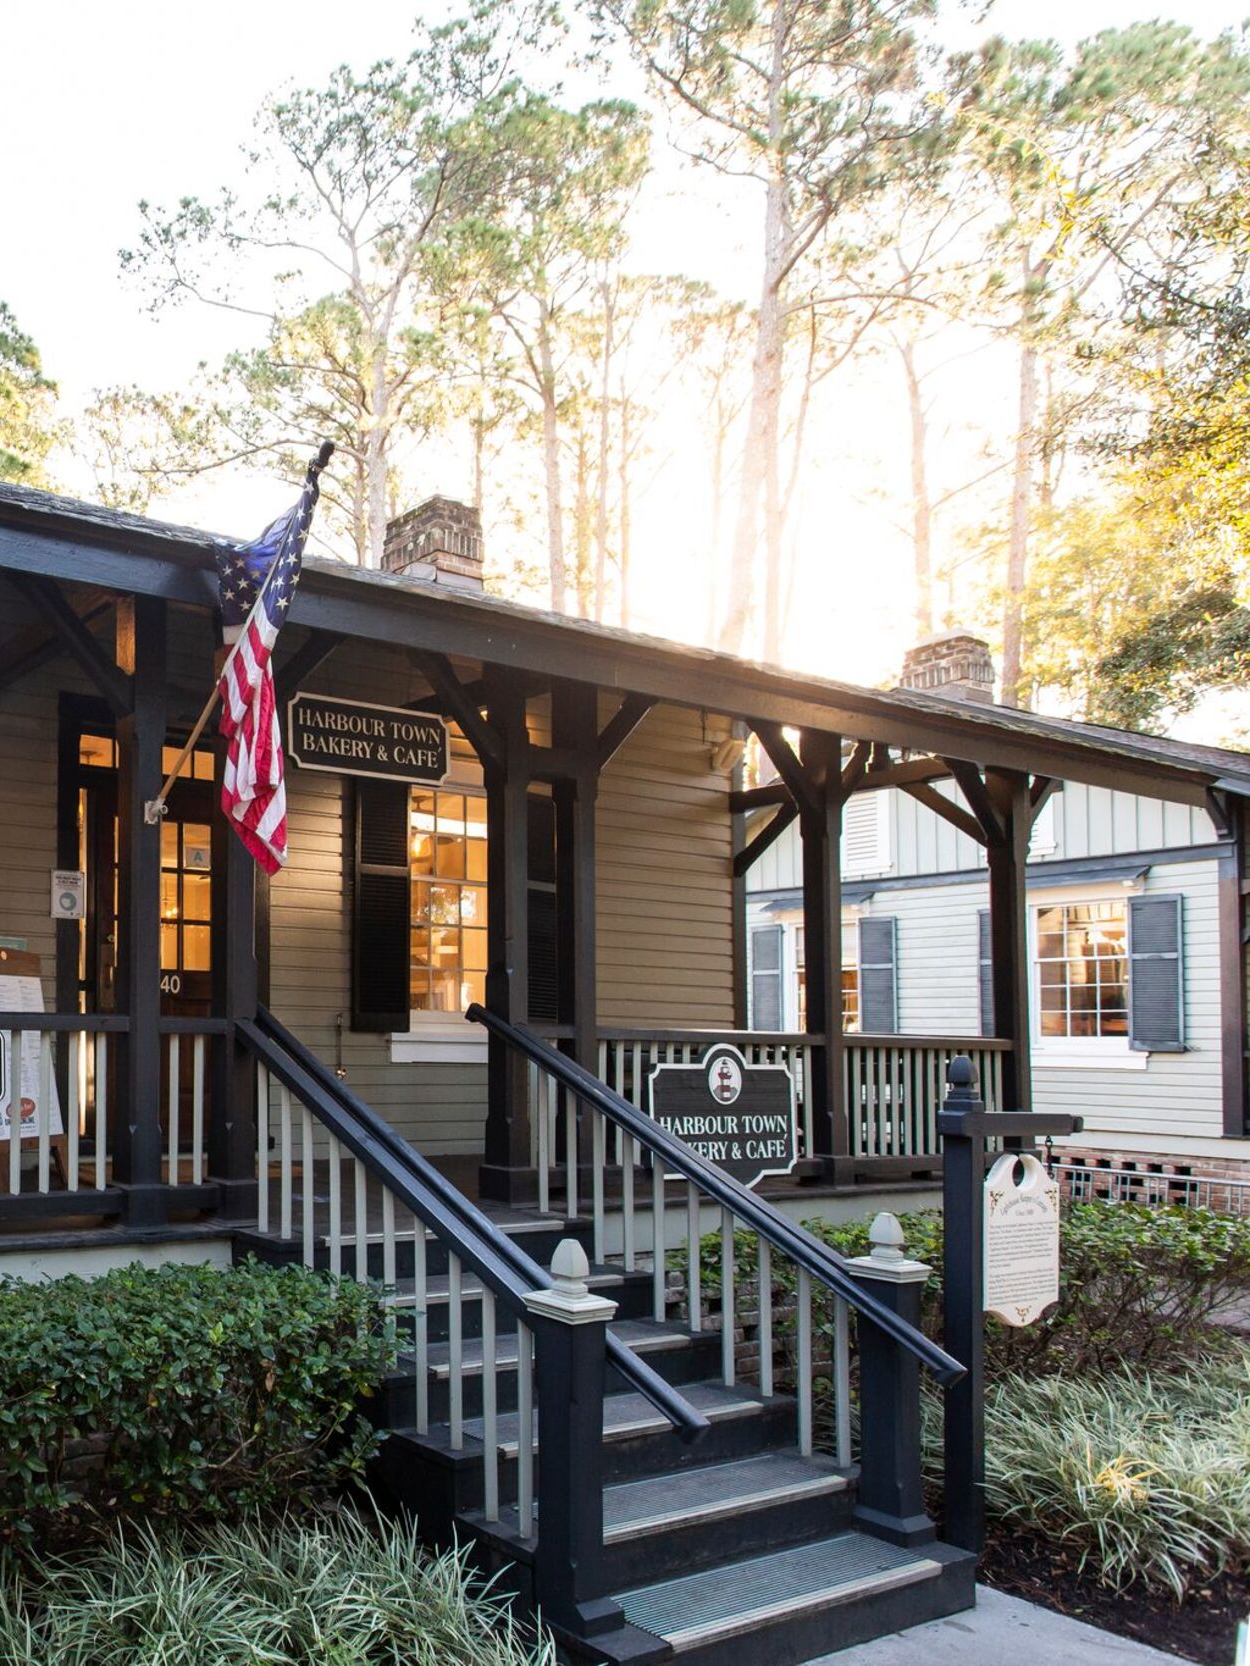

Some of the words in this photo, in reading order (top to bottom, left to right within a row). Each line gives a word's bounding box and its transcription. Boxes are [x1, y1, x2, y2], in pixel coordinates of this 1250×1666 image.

[298, 707, 386, 738] HARBOUR
[389, 721, 441, 745] TOWN
[303, 732, 374, 759] BAKERY
[376, 744, 389, 762] &
[193, 851, 203, 862] A
[160, 975, 181, 994] 40
[660, 1115, 739, 1136] HARBOUR
[741, 1115, 787, 1134] TOWN
[731, 1143, 742, 1160] &
